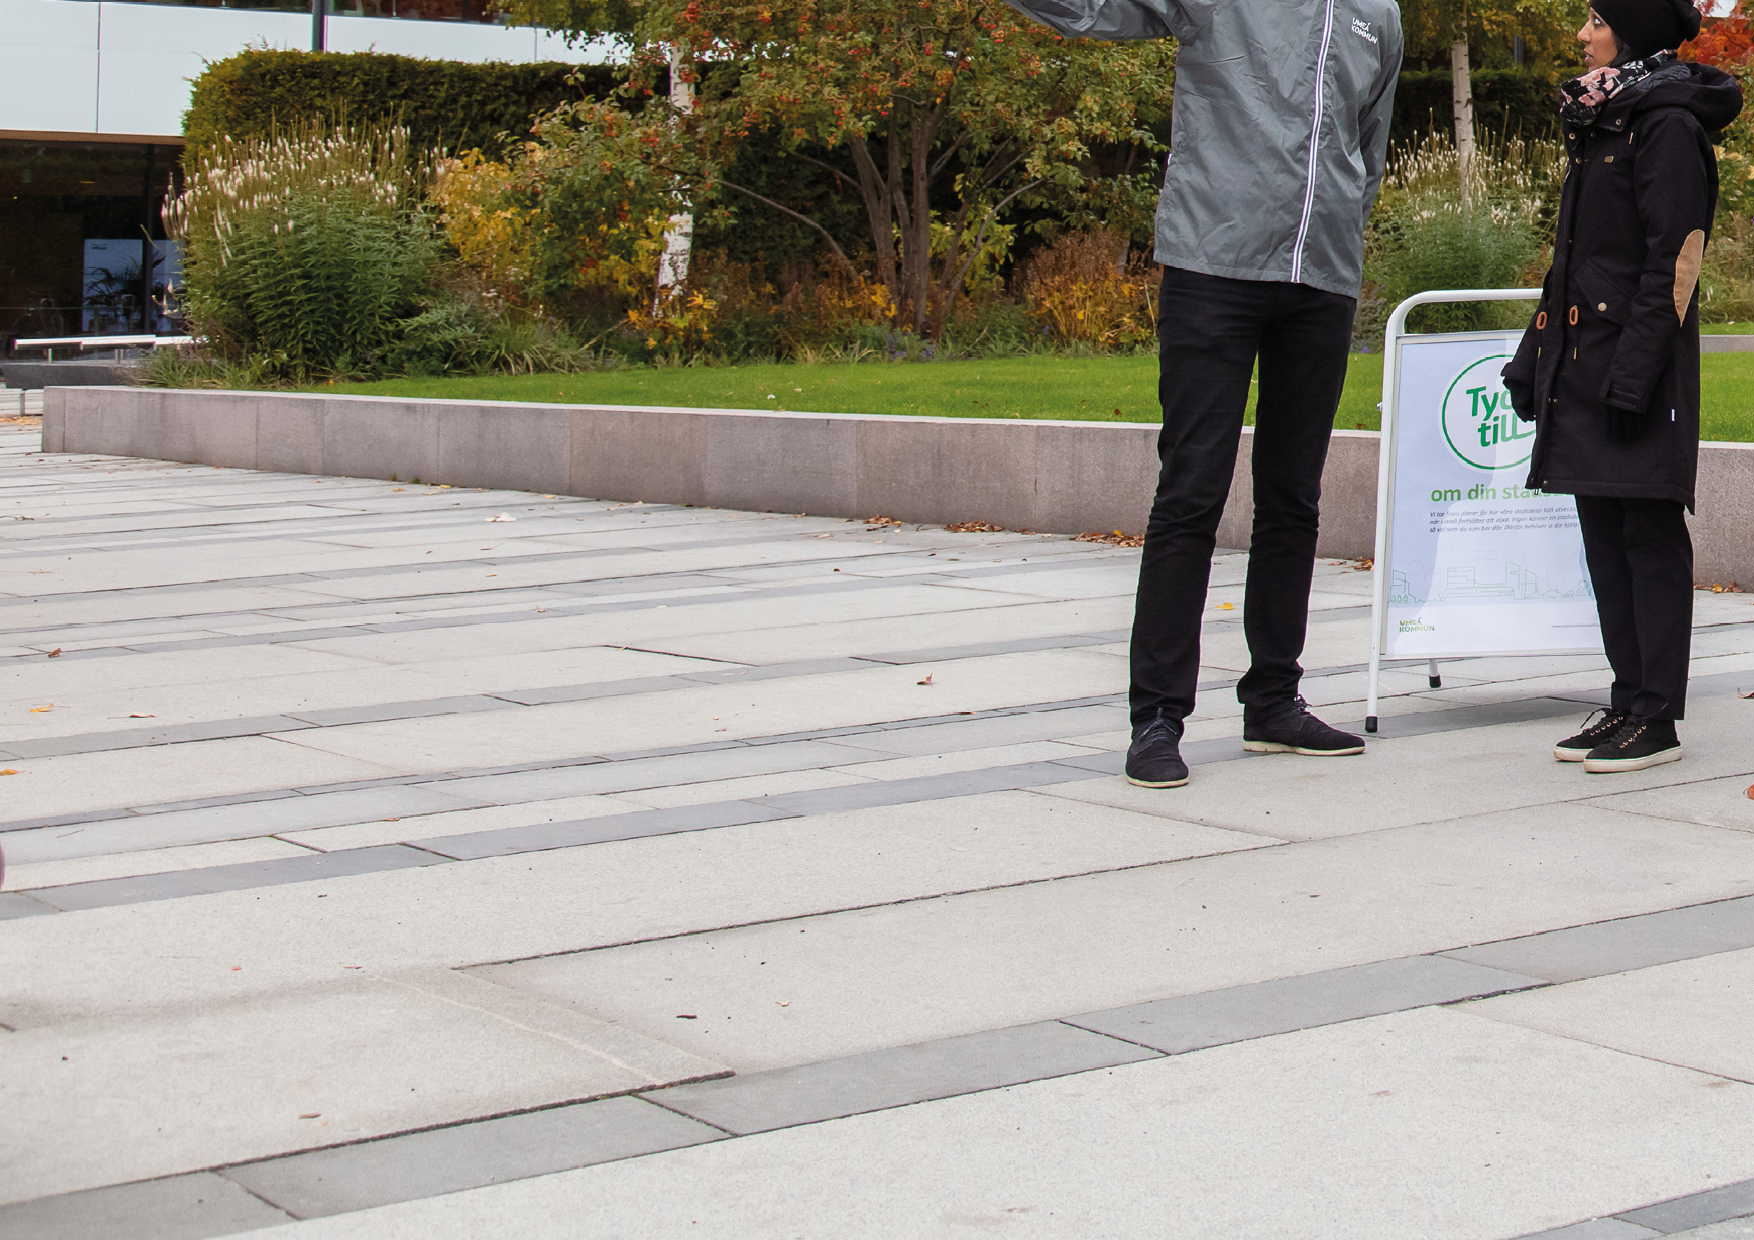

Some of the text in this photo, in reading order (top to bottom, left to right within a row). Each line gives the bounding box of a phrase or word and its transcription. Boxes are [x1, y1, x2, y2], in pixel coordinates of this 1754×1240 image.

[1351, 24, 1378, 44] KOMMUN
[1352, 17, 1371, 32] UMEÅ
[1466, 386, 1512, 421] Tyc
[1478, 413, 1525, 447] till
[1431, 488, 1461, 502] om
[1467, 483, 1496, 500] din
